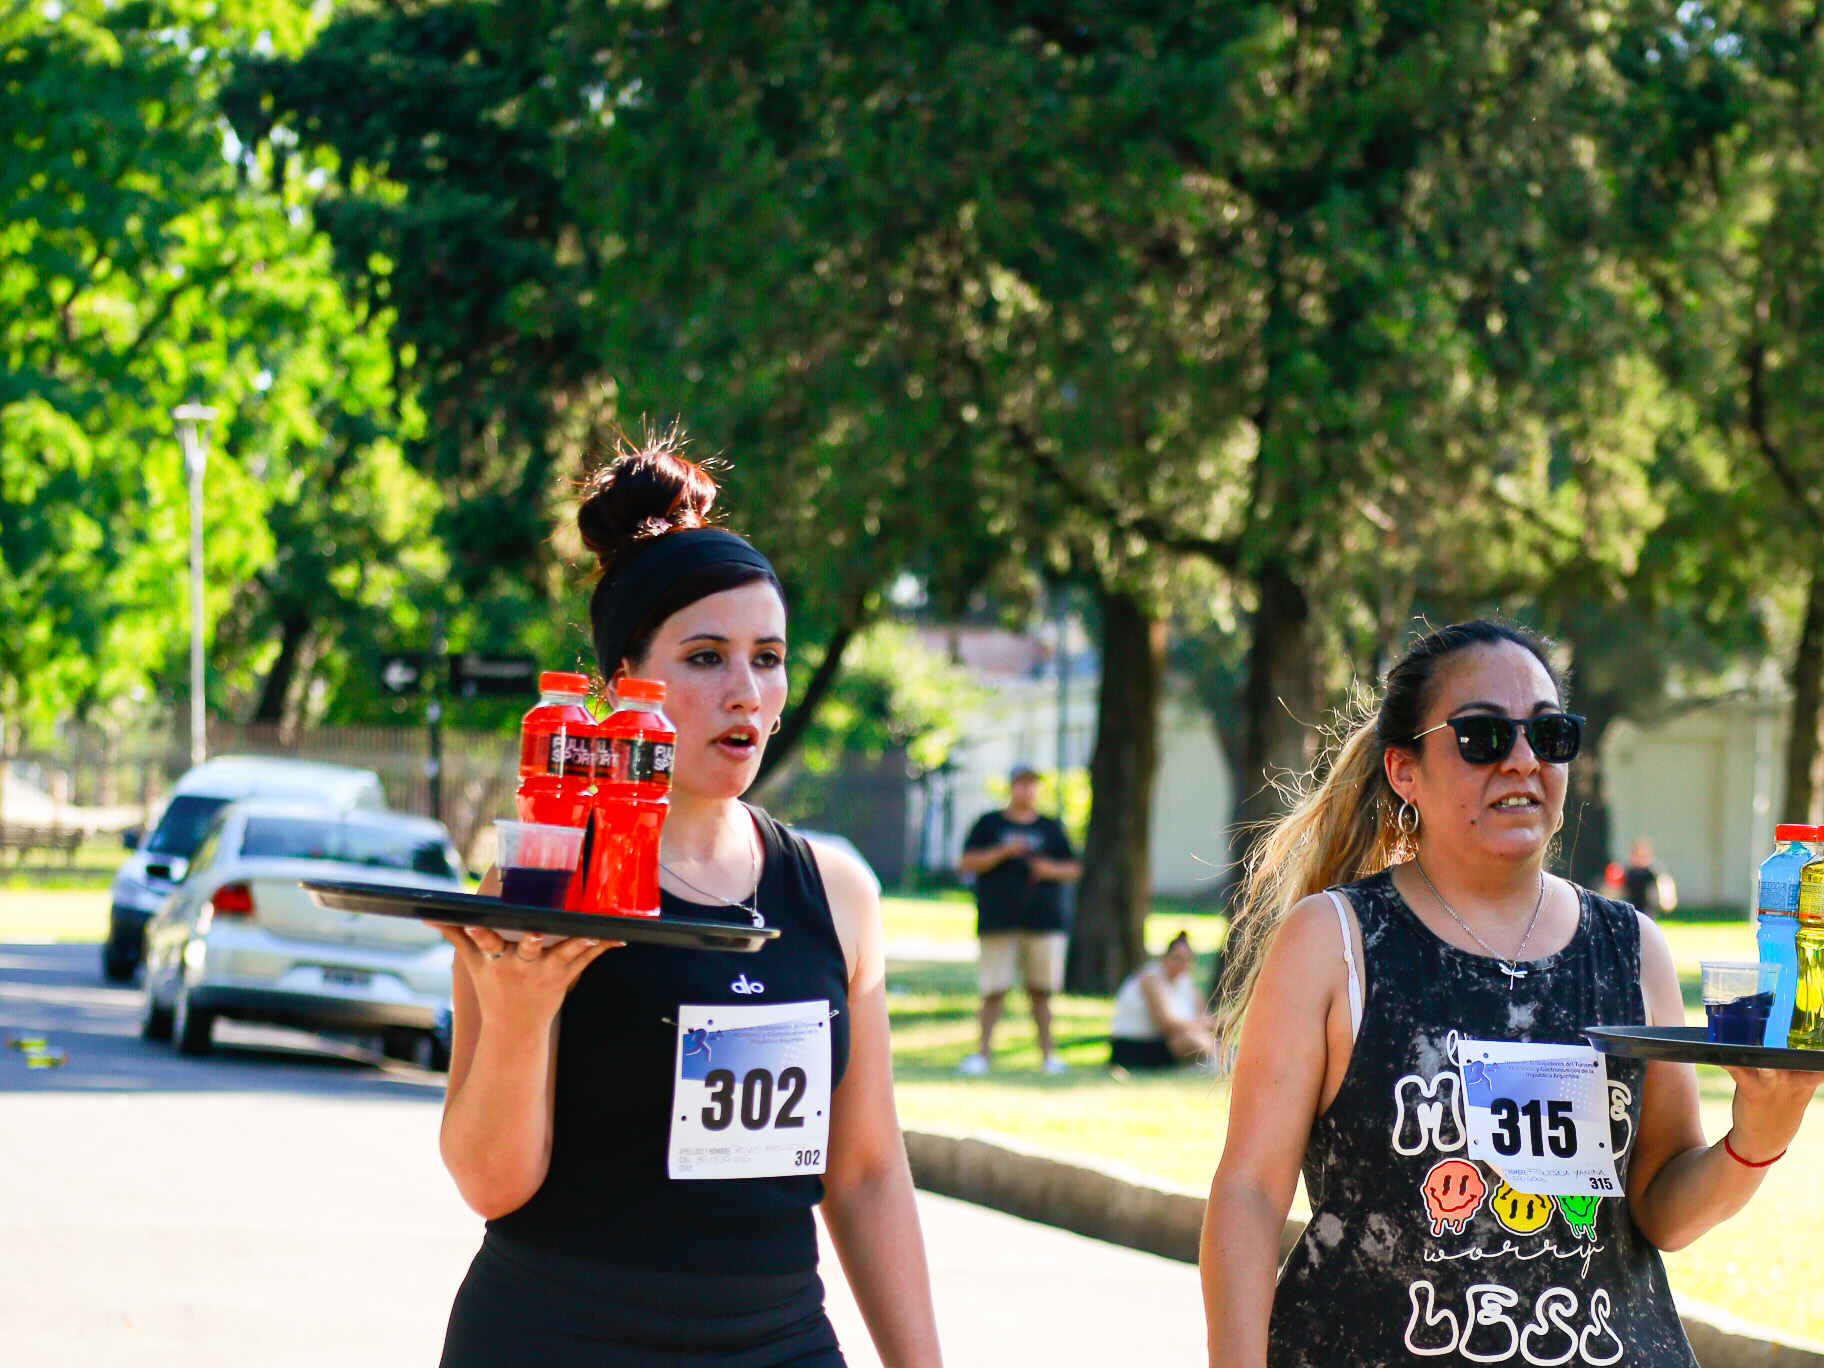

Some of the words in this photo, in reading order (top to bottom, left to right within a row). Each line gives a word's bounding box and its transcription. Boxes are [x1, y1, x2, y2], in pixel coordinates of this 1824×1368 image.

[701, 1066, 807, 1132] 302
[1490, 1097, 1578, 1159] 315
[795, 1149, 821, 1167] 302
[1589, 1177, 1614, 1191] 315
[1424, 1238, 1605, 1280] worry
[1404, 1280, 1624, 1367] LESS
